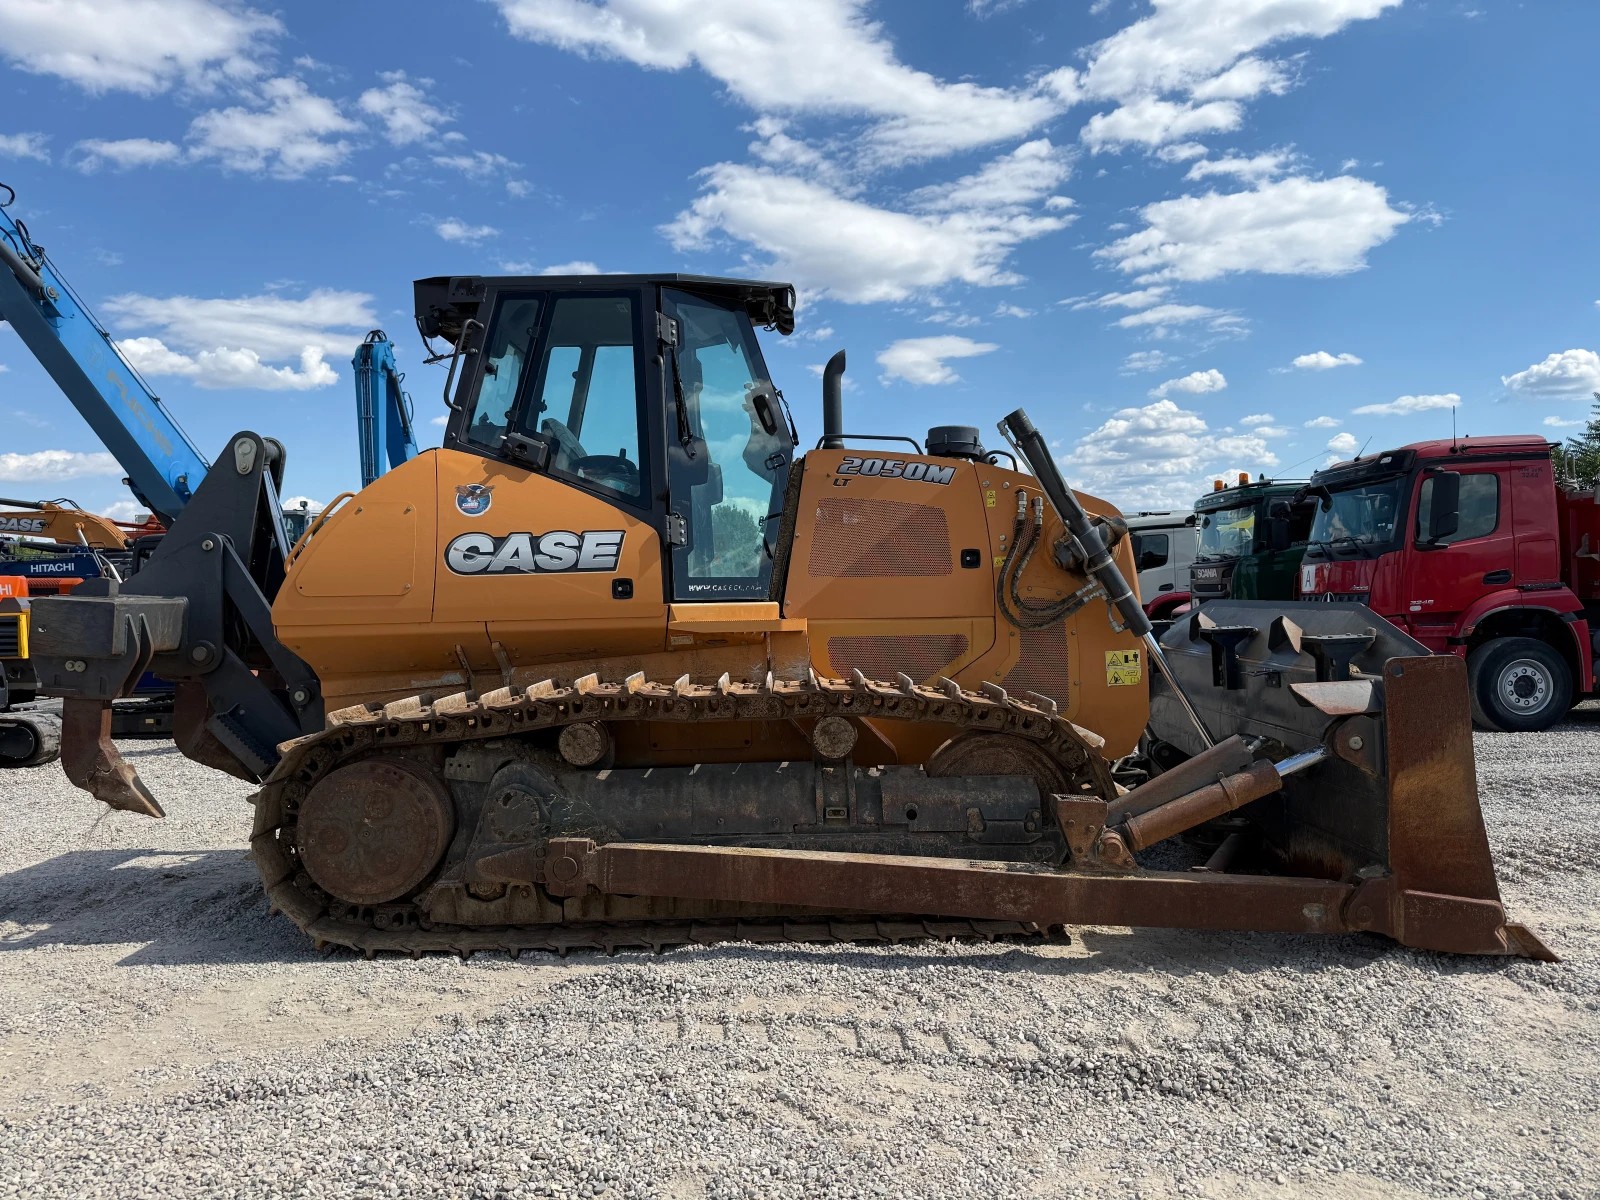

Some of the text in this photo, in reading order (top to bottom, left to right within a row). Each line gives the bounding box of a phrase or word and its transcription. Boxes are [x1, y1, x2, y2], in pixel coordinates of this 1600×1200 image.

[836, 456, 957, 485] 2050M
[833, 478, 852, 487] LT
[445, 531, 625, 575] CASE
[30, 562, 75, 573] HITACHI
[1197, 568, 1218, 578] SCANIA
[1304, 570, 1312, 588] A
